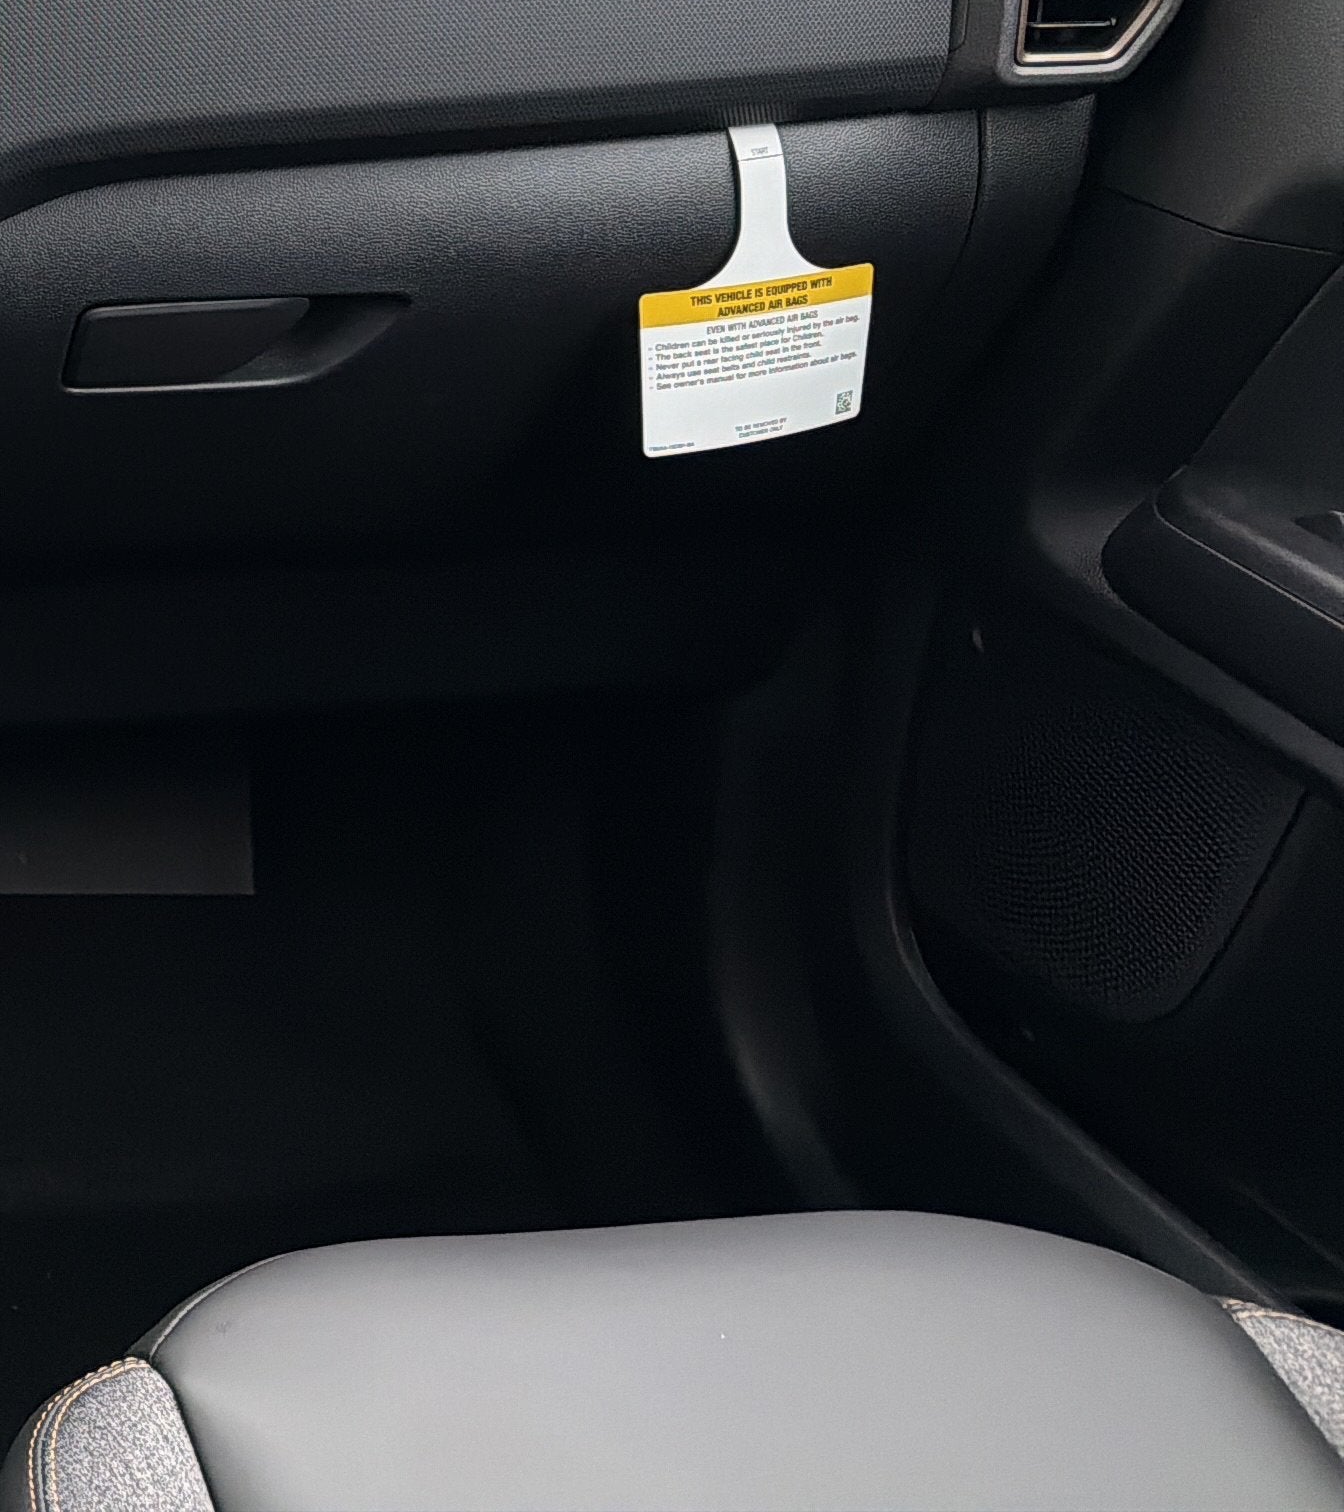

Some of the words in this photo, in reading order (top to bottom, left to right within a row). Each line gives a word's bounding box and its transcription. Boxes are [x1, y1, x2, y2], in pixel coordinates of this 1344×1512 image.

[690, 295, 712, 306] THIS
[714, 290, 753, 303] VEHICLE
[754, 288, 763, 298] IS
[765, 282, 808, 296] EQUIPPED
[810, 276, 833, 289] WITH
[717, 302, 765, 317] ADVANCED
[767, 299, 783, 310] AIR
[785, 294, 809, 306] BAGS
[706, 325, 725, 335] EVEN
[727, 322, 747, 332] WITH
[749, 316, 785, 328] ADVANCED
[787, 313, 799, 322] AIR
[800, 310, 819, 320] BAGS
[655, 342, 689, 351] Children
[719, 335, 740, 343] killed
[752, 328, 785, 339] seriously
[787, 323, 811, 333] injured
[655, 353, 671, 361] The
[672, 350, 692, 359] back
[760, 339, 779, 348] place
[656, 362, 679, 371] Never
[681, 360, 694, 369] put
[720, 354, 744, 363] facing
[746, 350, 763, 359] child
[656, 372, 685, 381] Always
[721, 364, 740, 372] belts
[757, 358, 775, 367] child
[706, 374, 734, 384] manual
[748, 369, 767, 378] more
[768, 362, 809, 374] information
[810, 357, 829, 366] about
